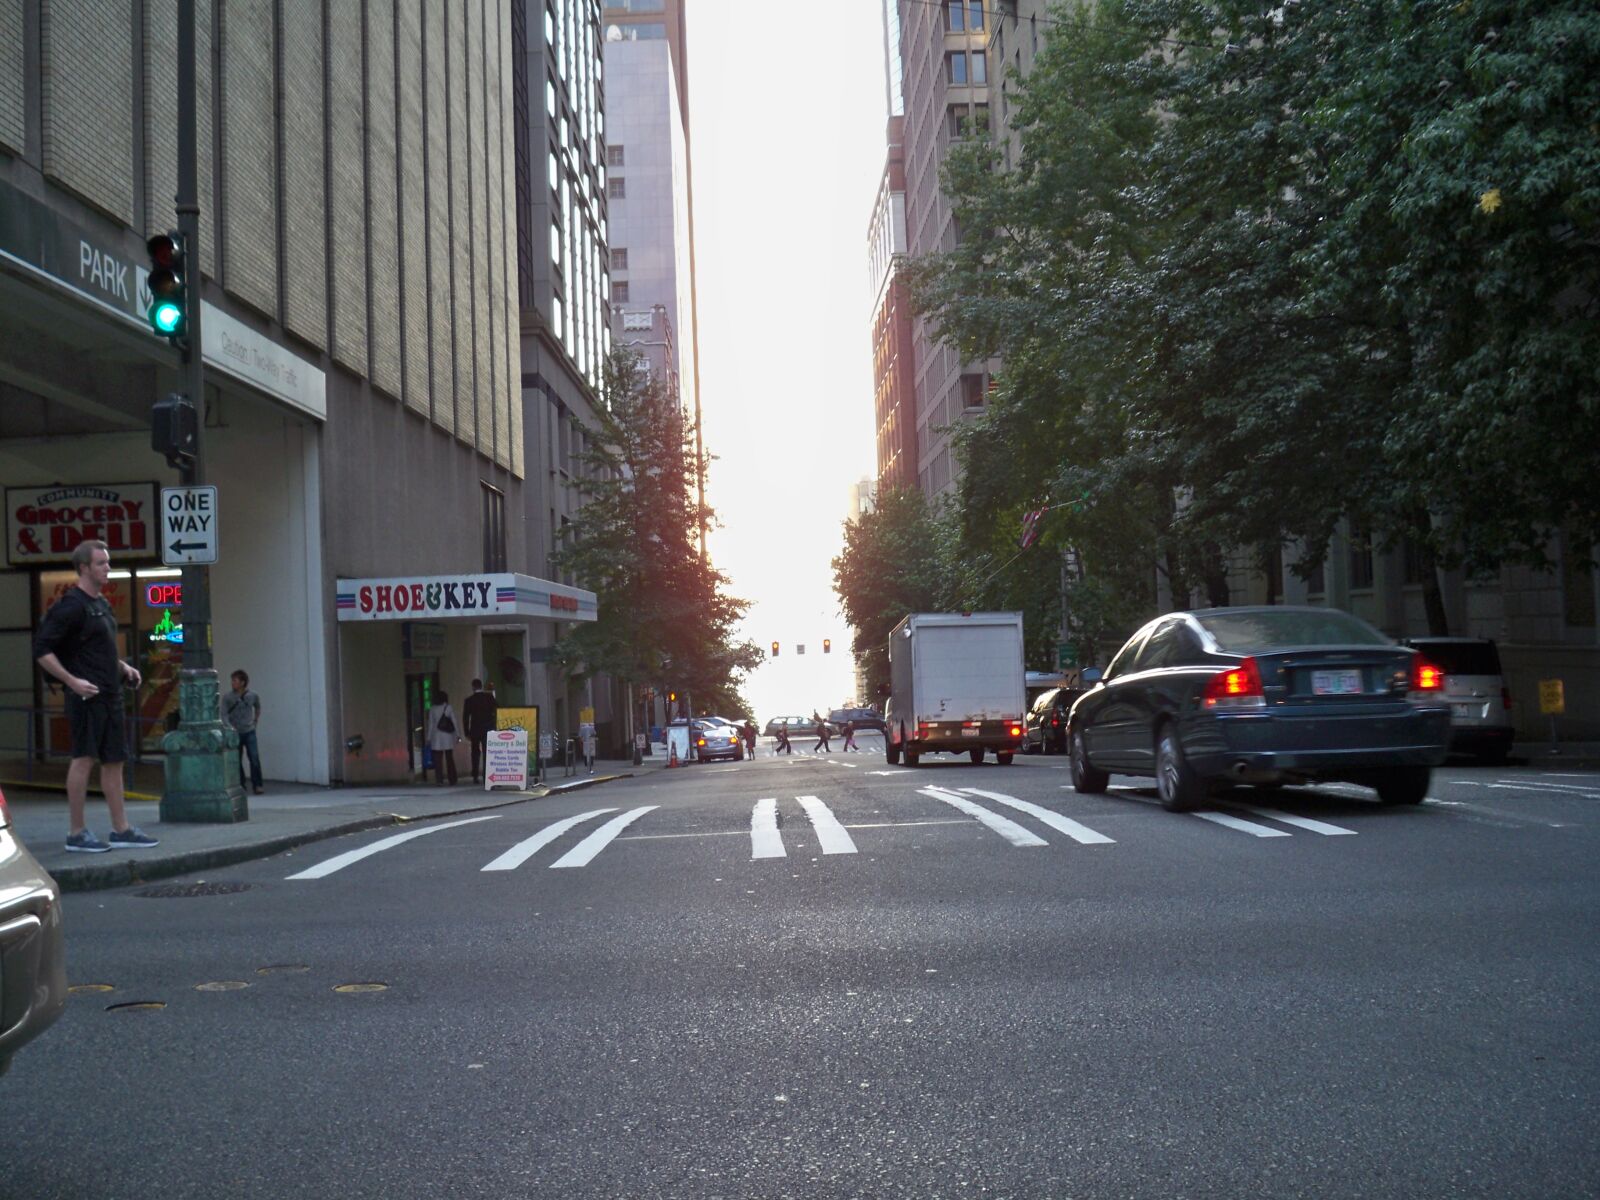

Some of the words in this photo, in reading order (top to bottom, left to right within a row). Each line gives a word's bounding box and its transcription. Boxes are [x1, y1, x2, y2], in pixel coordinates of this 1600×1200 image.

[80, 240, 128, 302] PARK
[40, 487, 118, 504] COMMUNITY
[168, 494, 210, 511] ONE
[168, 515, 211, 533] WAY
[17, 527, 42, 555] &
[51, 521, 146, 553] DELI
[148, 585, 182, 604] OPE
